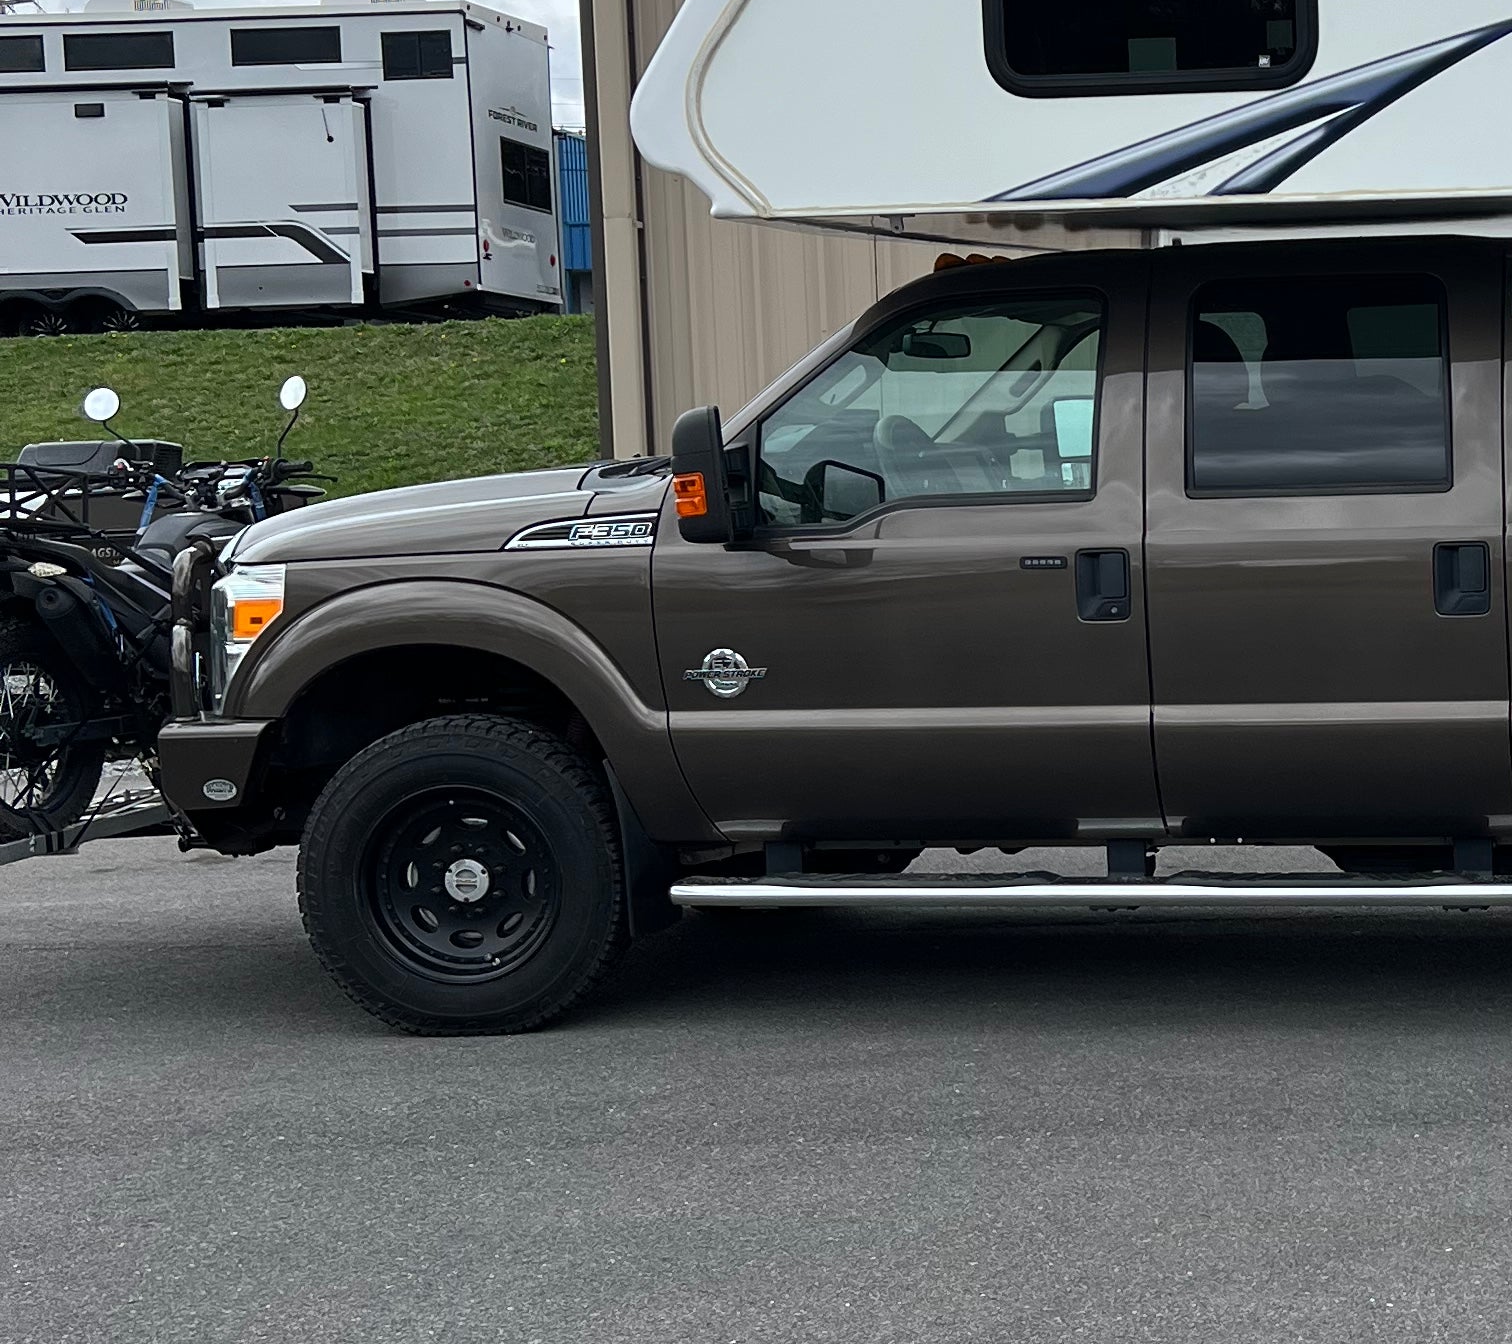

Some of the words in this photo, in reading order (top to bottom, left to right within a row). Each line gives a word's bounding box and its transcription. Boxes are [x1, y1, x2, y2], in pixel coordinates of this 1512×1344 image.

[83, 205, 125, 214] GLEN
[682, 669, 721, 680] POWER
[722, 668, 768, 678] STROKE
